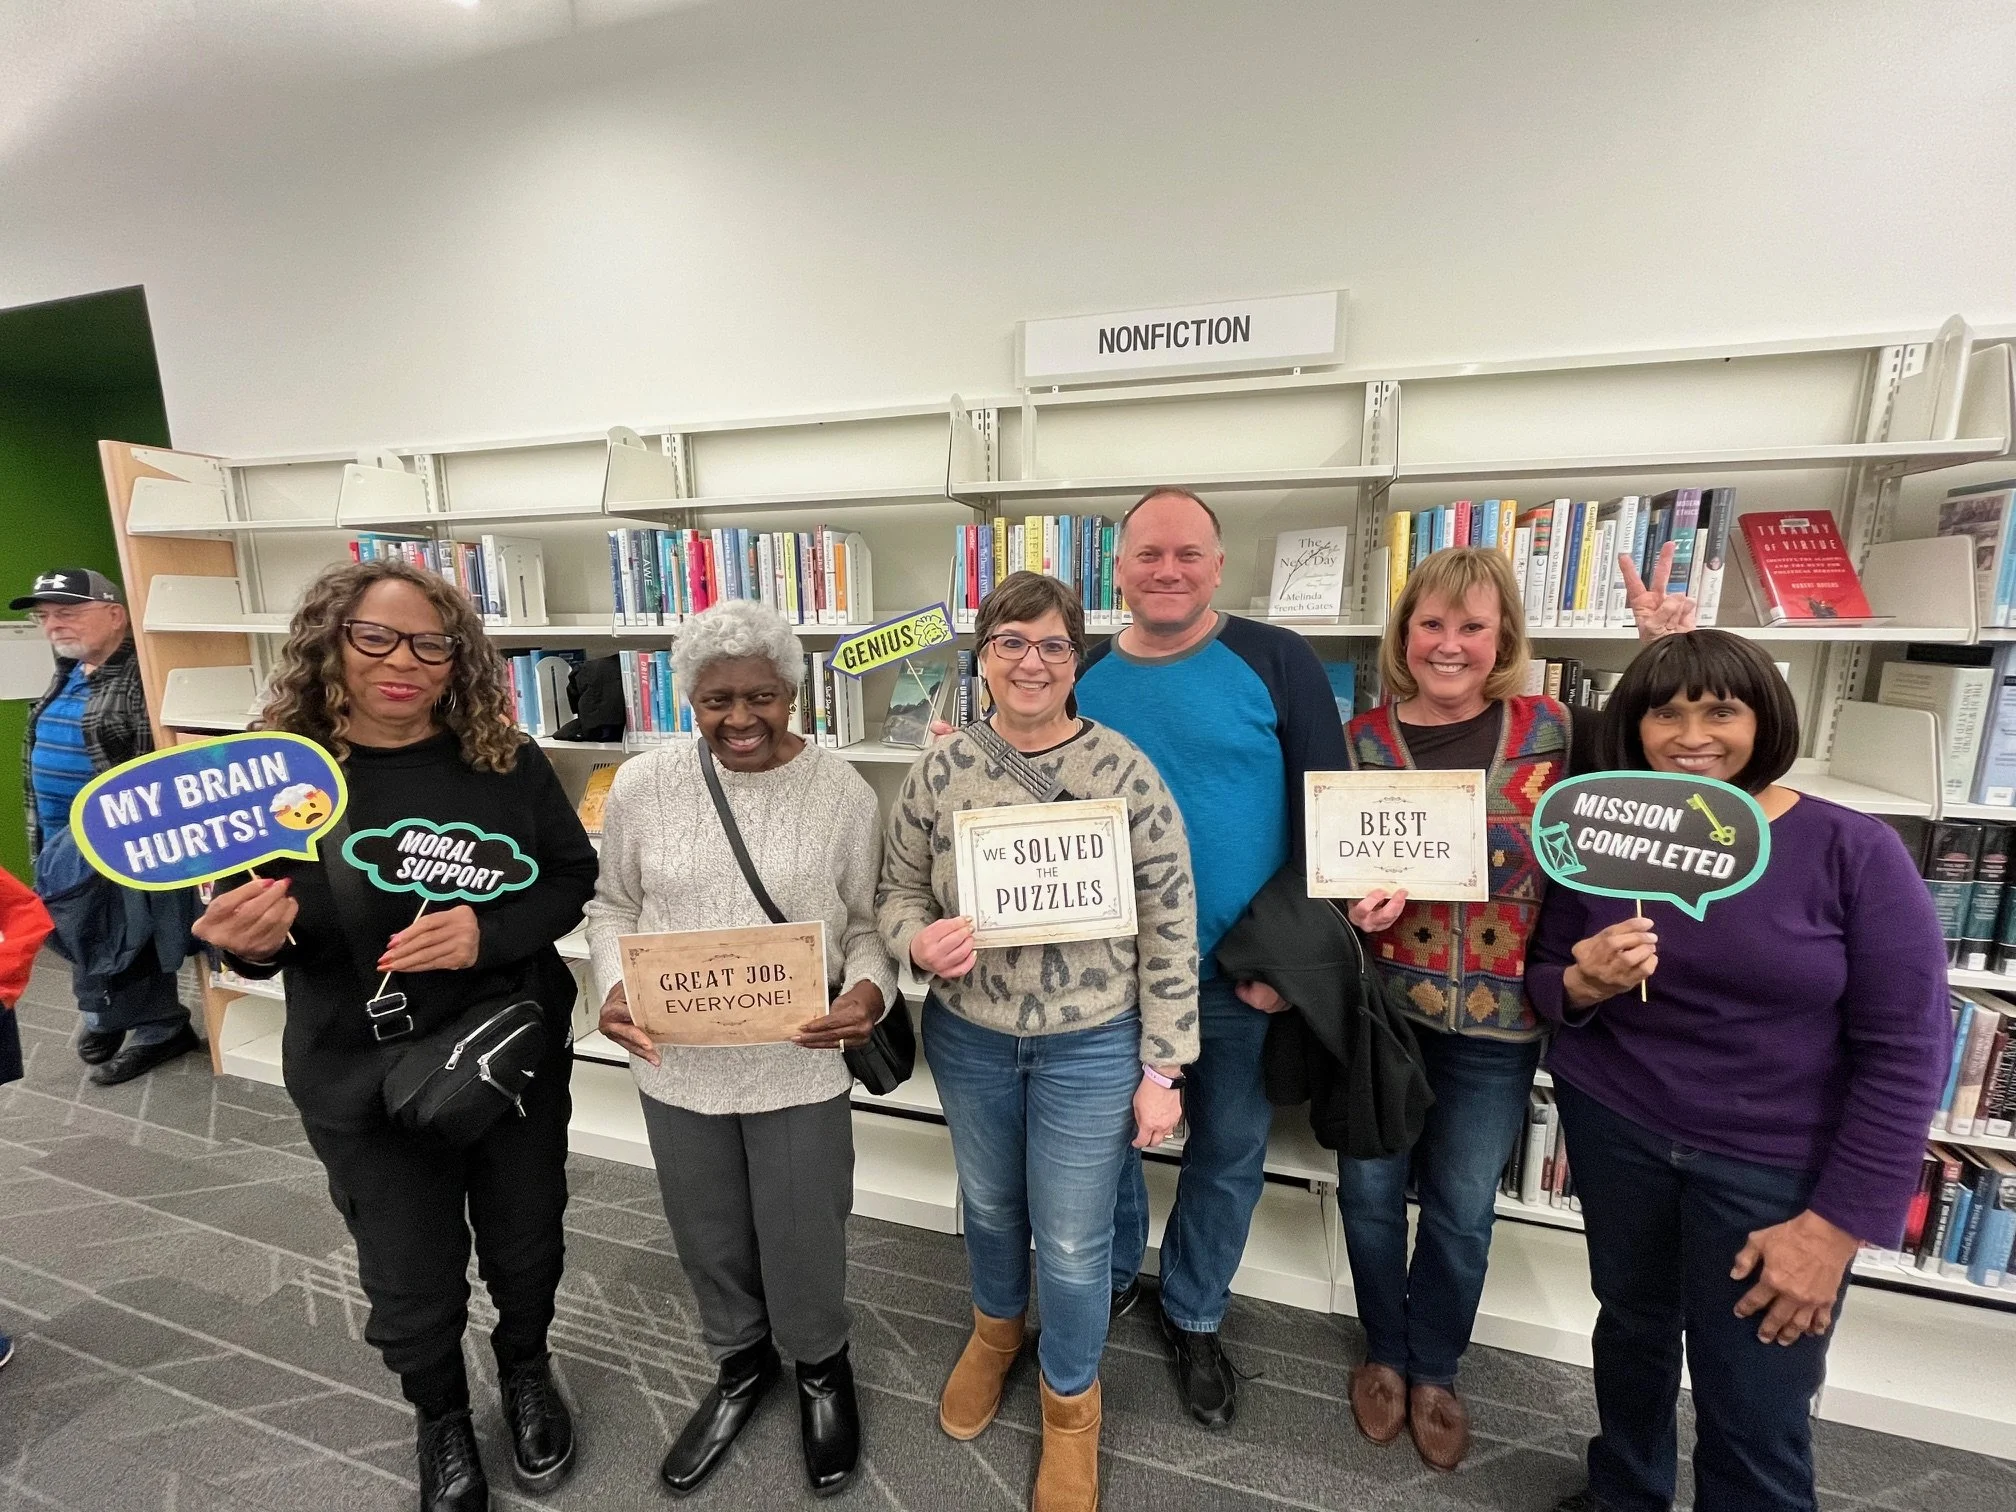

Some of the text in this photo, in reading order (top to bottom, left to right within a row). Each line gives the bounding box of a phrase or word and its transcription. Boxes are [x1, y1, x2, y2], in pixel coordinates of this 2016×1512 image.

[1098, 315, 1251, 354] NONFICTION
[994, 520, 1002, 543] FAILURE
[1584, 505, 1596, 542] Gaslighting
[1298, 537, 1322, 553] The
[1764, 540, 1837, 551] OF VIRTUE
[643, 558, 652, 586] AWE
[1314, 555, 1337, 572] Day
[1274, 603, 1333, 612] French Gates
[1286, 592, 1322, 602] Melinda
[842, 625, 914, 669] GENIUS
[640, 660, 648, 685] DRIVE
[1954, 681, 1974, 734] ANNOTATED
[99, 751, 291, 829] MY BRAIN
[1360, 811, 1427, 836] BEST
[1573, 792, 1685, 833] MISSION
[124, 805, 270, 873] HURTS!
[397, 830, 477, 864] MORAL
[983, 834, 1104, 865] WE SOLVED
[1339, 840, 1450, 859] DAY EVER
[1576, 826, 1737, 880] COMPLETED
[396, 856, 505, 891] SUPPORT
[1036, 867, 1059, 878] THE
[996, 879, 1104, 914] PUZZLES
[659, 963, 793, 992] GREAT JOB.
[665, 989, 792, 1014] EVERYONE!
[1969, 1203, 1982, 1230] Broken
